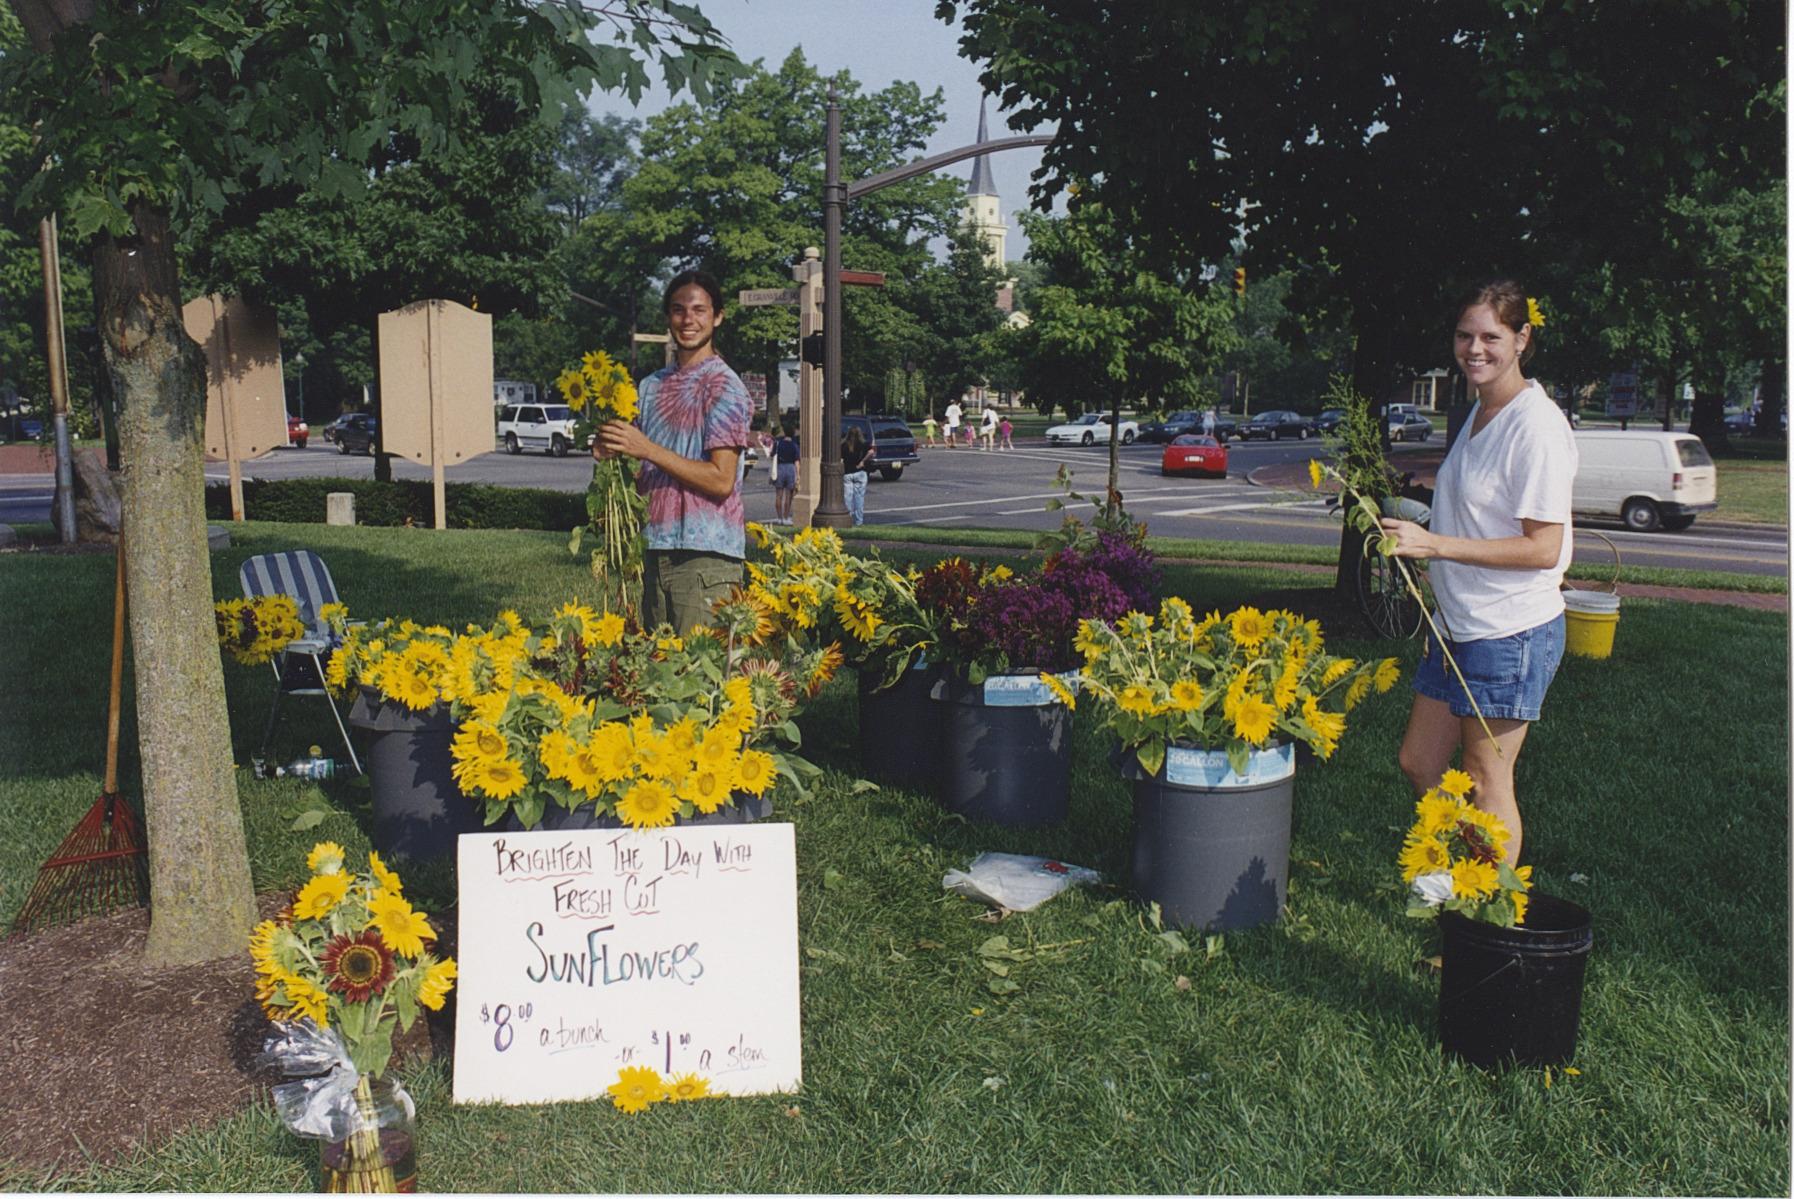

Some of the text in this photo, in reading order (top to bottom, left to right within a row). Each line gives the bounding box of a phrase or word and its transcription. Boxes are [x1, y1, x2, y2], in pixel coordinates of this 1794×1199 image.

[1182, 756, 1225, 768] GALLON
[493, 838, 593, 876] BRIGHTEN
[607, 833, 644, 872] THE
[713, 838, 752, 864] WITH
[553, 879, 612, 914] FRESH
[539, 1028, 553, 1047] a
[557, 1016, 610, 1048] bunch
[699, 1049, 712, 1070] a
[727, 1033, 768, 1067] stem
